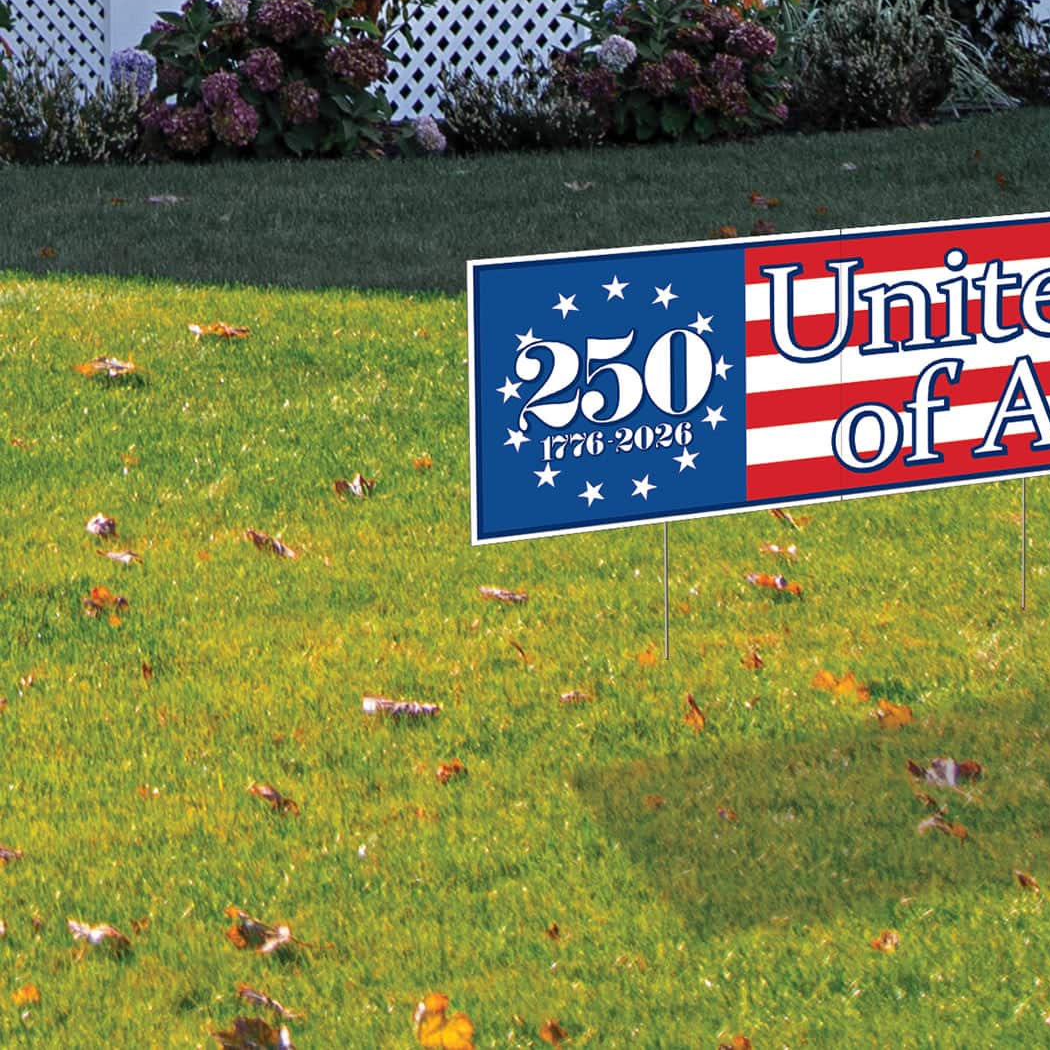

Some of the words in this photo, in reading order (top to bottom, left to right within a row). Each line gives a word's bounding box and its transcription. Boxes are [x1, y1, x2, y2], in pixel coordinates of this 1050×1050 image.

[515, 328, 713, 430] 250
[831, 359, 964, 474] of
[540, 421, 693, 462] 1776-2026
